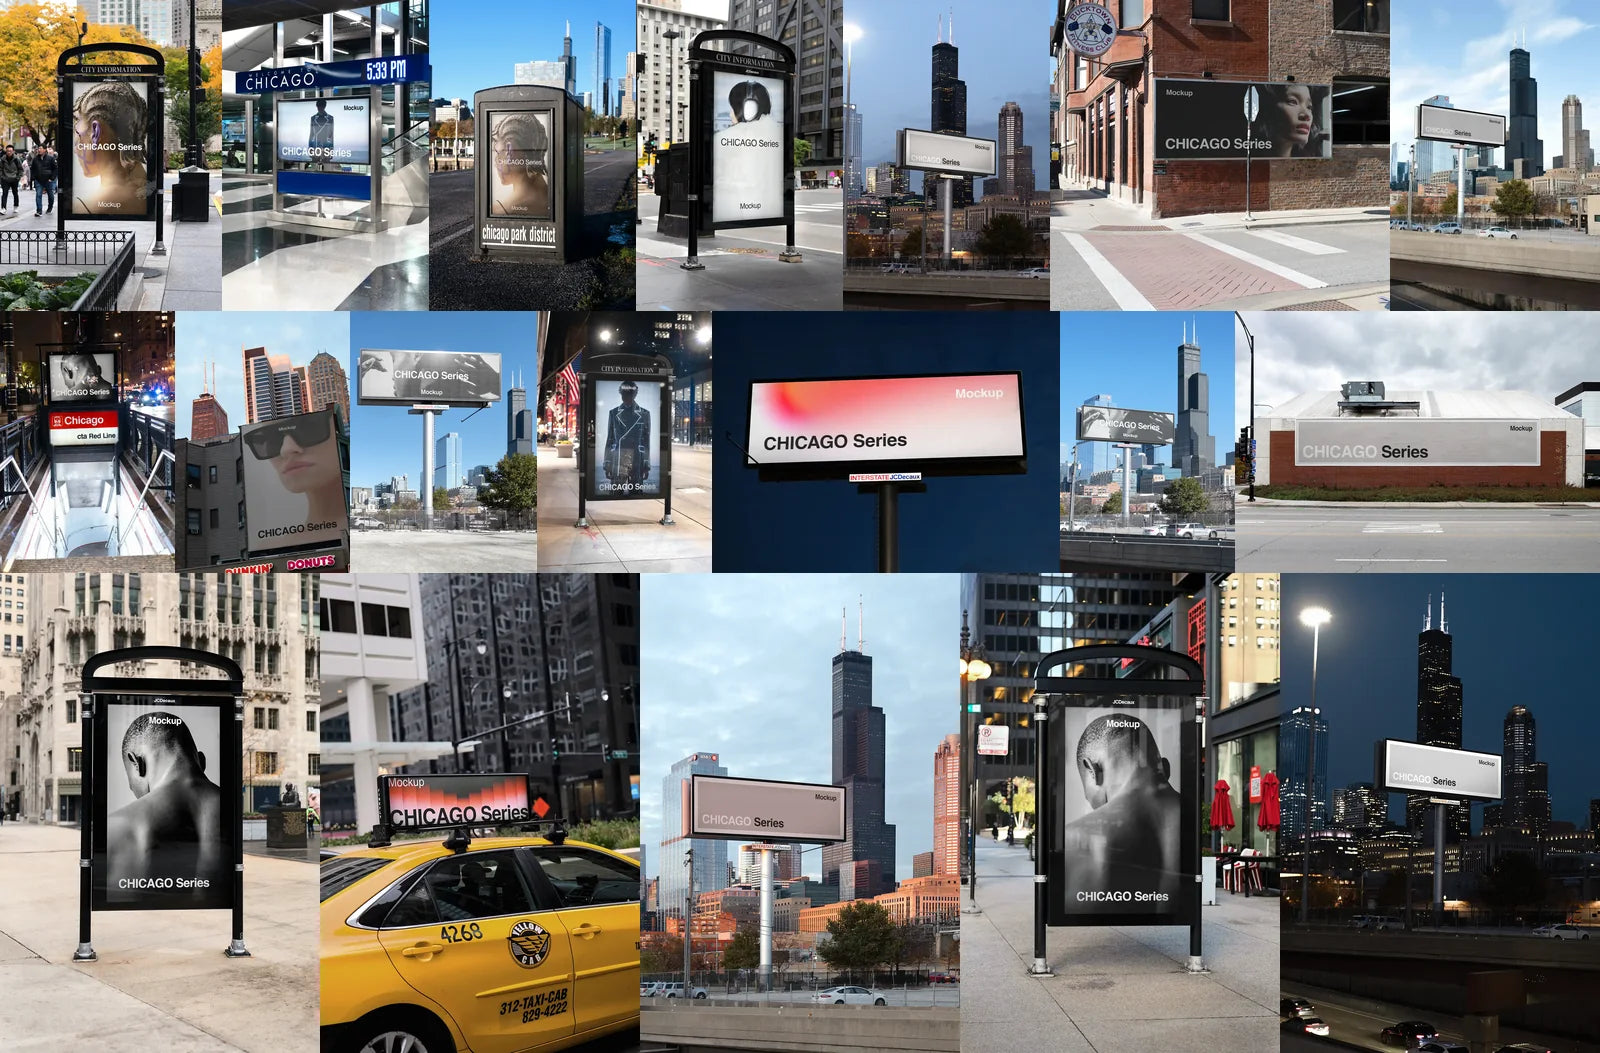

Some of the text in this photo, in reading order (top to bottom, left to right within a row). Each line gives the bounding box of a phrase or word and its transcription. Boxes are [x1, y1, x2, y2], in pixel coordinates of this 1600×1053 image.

[1070, 6, 1112, 24] BUCKTOWN
[1069, 33, 1112, 52] FITNESS CLUB
[716, 53, 774, 68] CITY INFORMATION
[366, 59, 407, 81] 5:33 PM
[246, 72, 315, 90] CHICAGO
[1165, 88, 1194, 98] Mockup
[343, 104, 364, 113] Mockup
[1454, 129, 1472, 138] Series
[77, 142, 142, 151] CHICAGO Series
[720, 137, 780, 148] CHICAGO Series
[1164, 137, 1272, 150] CHICAGO Series
[282, 146, 352, 158] CHICAGO Series
[498, 158, 542, 166] CHICAGO Series
[942, 158, 960, 166] Series
[98, 200, 122, 209] Mockup
[739, 202, 762, 211] Mockup
[482, 224, 556, 244] chicago park district
[394, 370, 470, 382] CHICAGO Series
[616, 366, 654, 374] INFORMATION
[56, 388, 110, 396] CHICAGO Series
[420, 388, 444, 396] Mockup
[955, 387, 1004, 400] Mockup
[64, 416, 104, 427] Chicago
[1100, 419, 1160, 432] CHICAGO Series
[88, 432, 102, 440] Red
[102, 432, 116, 440] Line
[763, 433, 907, 451] CHICAGO Series
[1302, 444, 1428, 459] CHICAGO Series
[599, 483, 634, 491] CHICAGO
[258, 520, 338, 539] CHICAGO Series
[287, 556, 335, 570] DONUTS
[149, 716, 182, 726] Mockup
[1106, 720, 1140, 730] Mockup
[1478, 759, 1496, 767] Mockup
[388, 777, 424, 788] Mockup
[1392, 771, 1456, 787] CHICAGO Series
[814, 793, 837, 802] Mockup
[390, 804, 529, 827] CHICAGO Series
[702, 814, 784, 828] CHICAGO Series
[118, 877, 210, 889] CHICAGO Series
[1076, 890, 1169, 902] CHICAGO Series
[440, 922, 483, 944] 4268
[512, 922, 544, 936] YELLOW
[522, 954, 542, 964] CAB
[500, 988, 568, 1016] 312-TAXI-CAB
[522, 1001, 568, 1024] 829-4222
